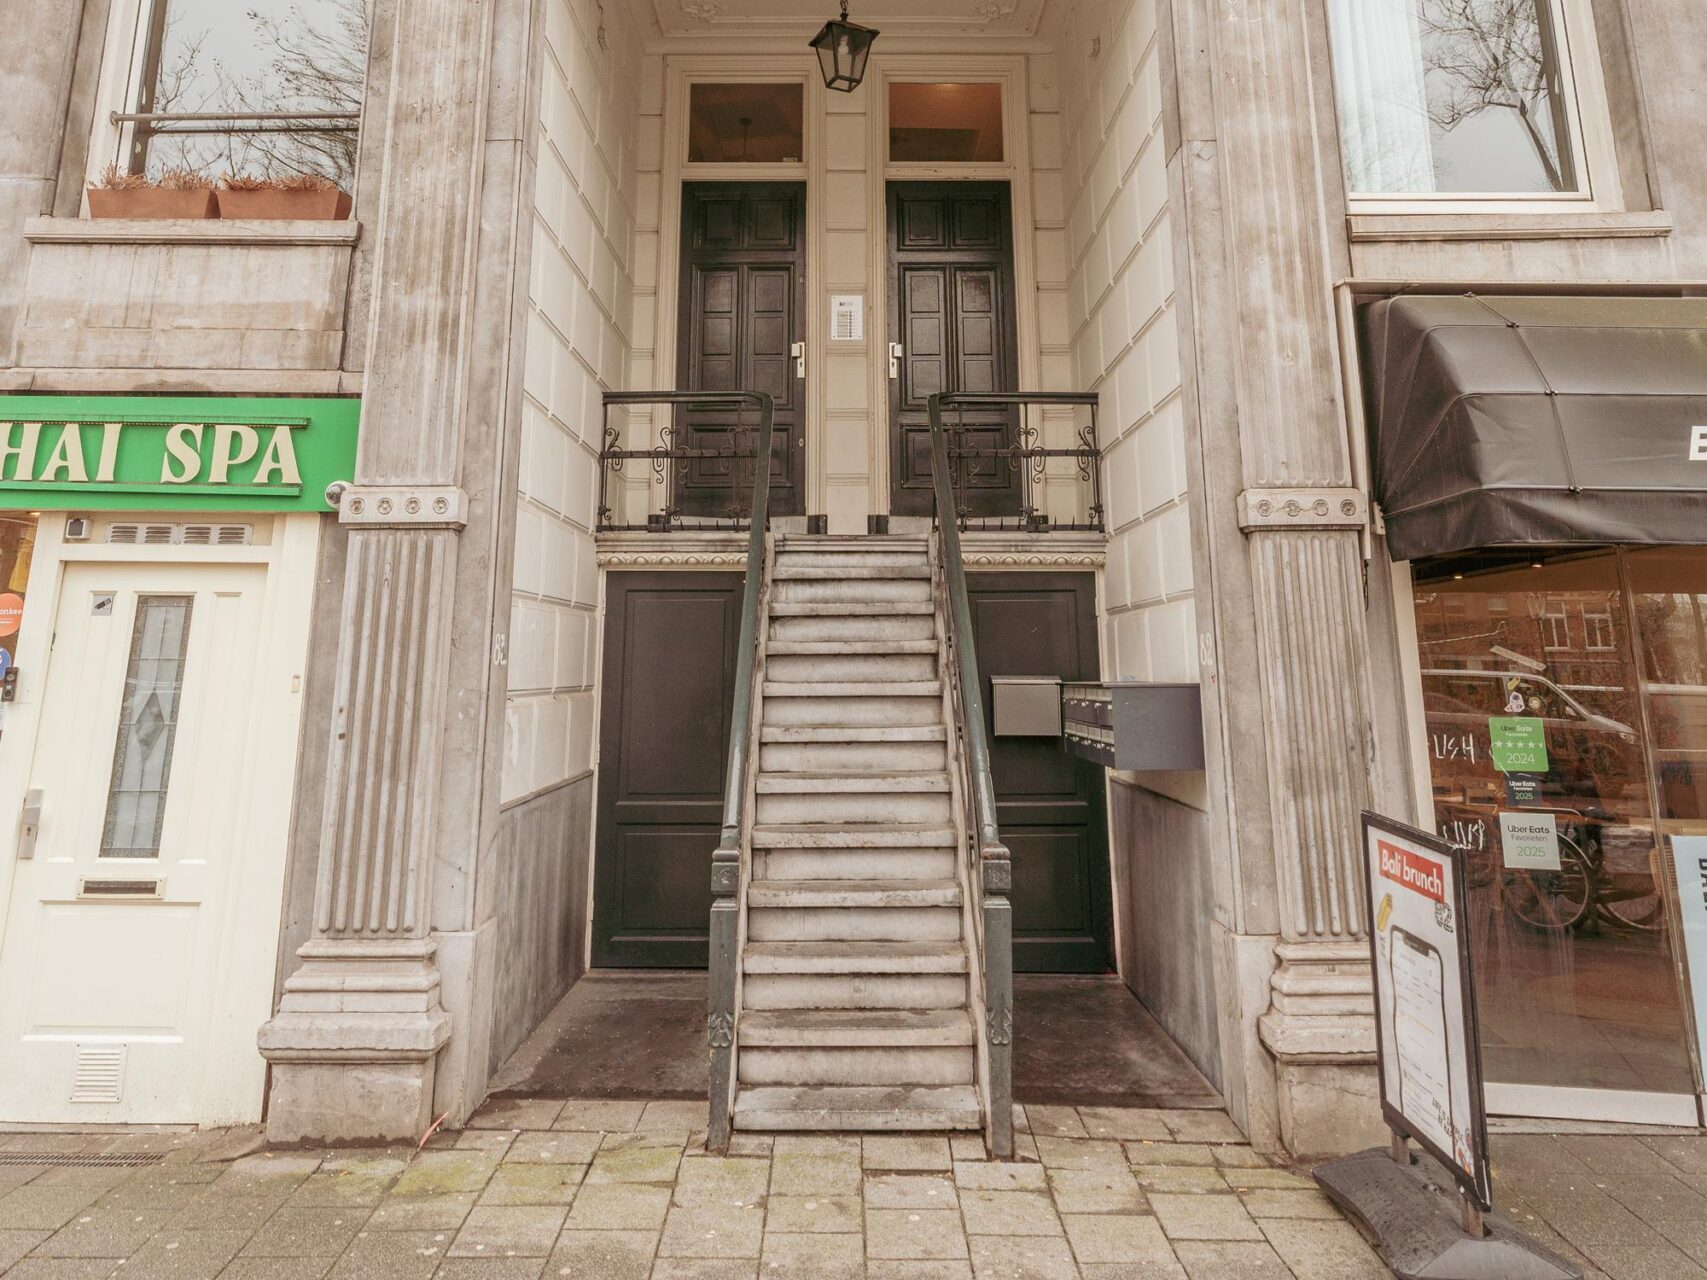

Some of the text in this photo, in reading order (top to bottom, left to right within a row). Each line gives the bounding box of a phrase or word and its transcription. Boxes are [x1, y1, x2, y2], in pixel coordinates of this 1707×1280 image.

[160, 423, 303, 485] SPA
[493, 633, 507, 665] 82
[1199, 633, 1213, 666] 82
[1516, 724, 1533, 732] Eats
[1506, 752, 1535, 765] 2024
[1515, 792, 1534, 800] 2025
[1507, 824, 1550, 834] Uber Eats
[1511, 833, 1548, 842] Favorieten
[1516, 846, 1546, 858] 2025
[1381, 847, 1442, 896] Bali brunch
